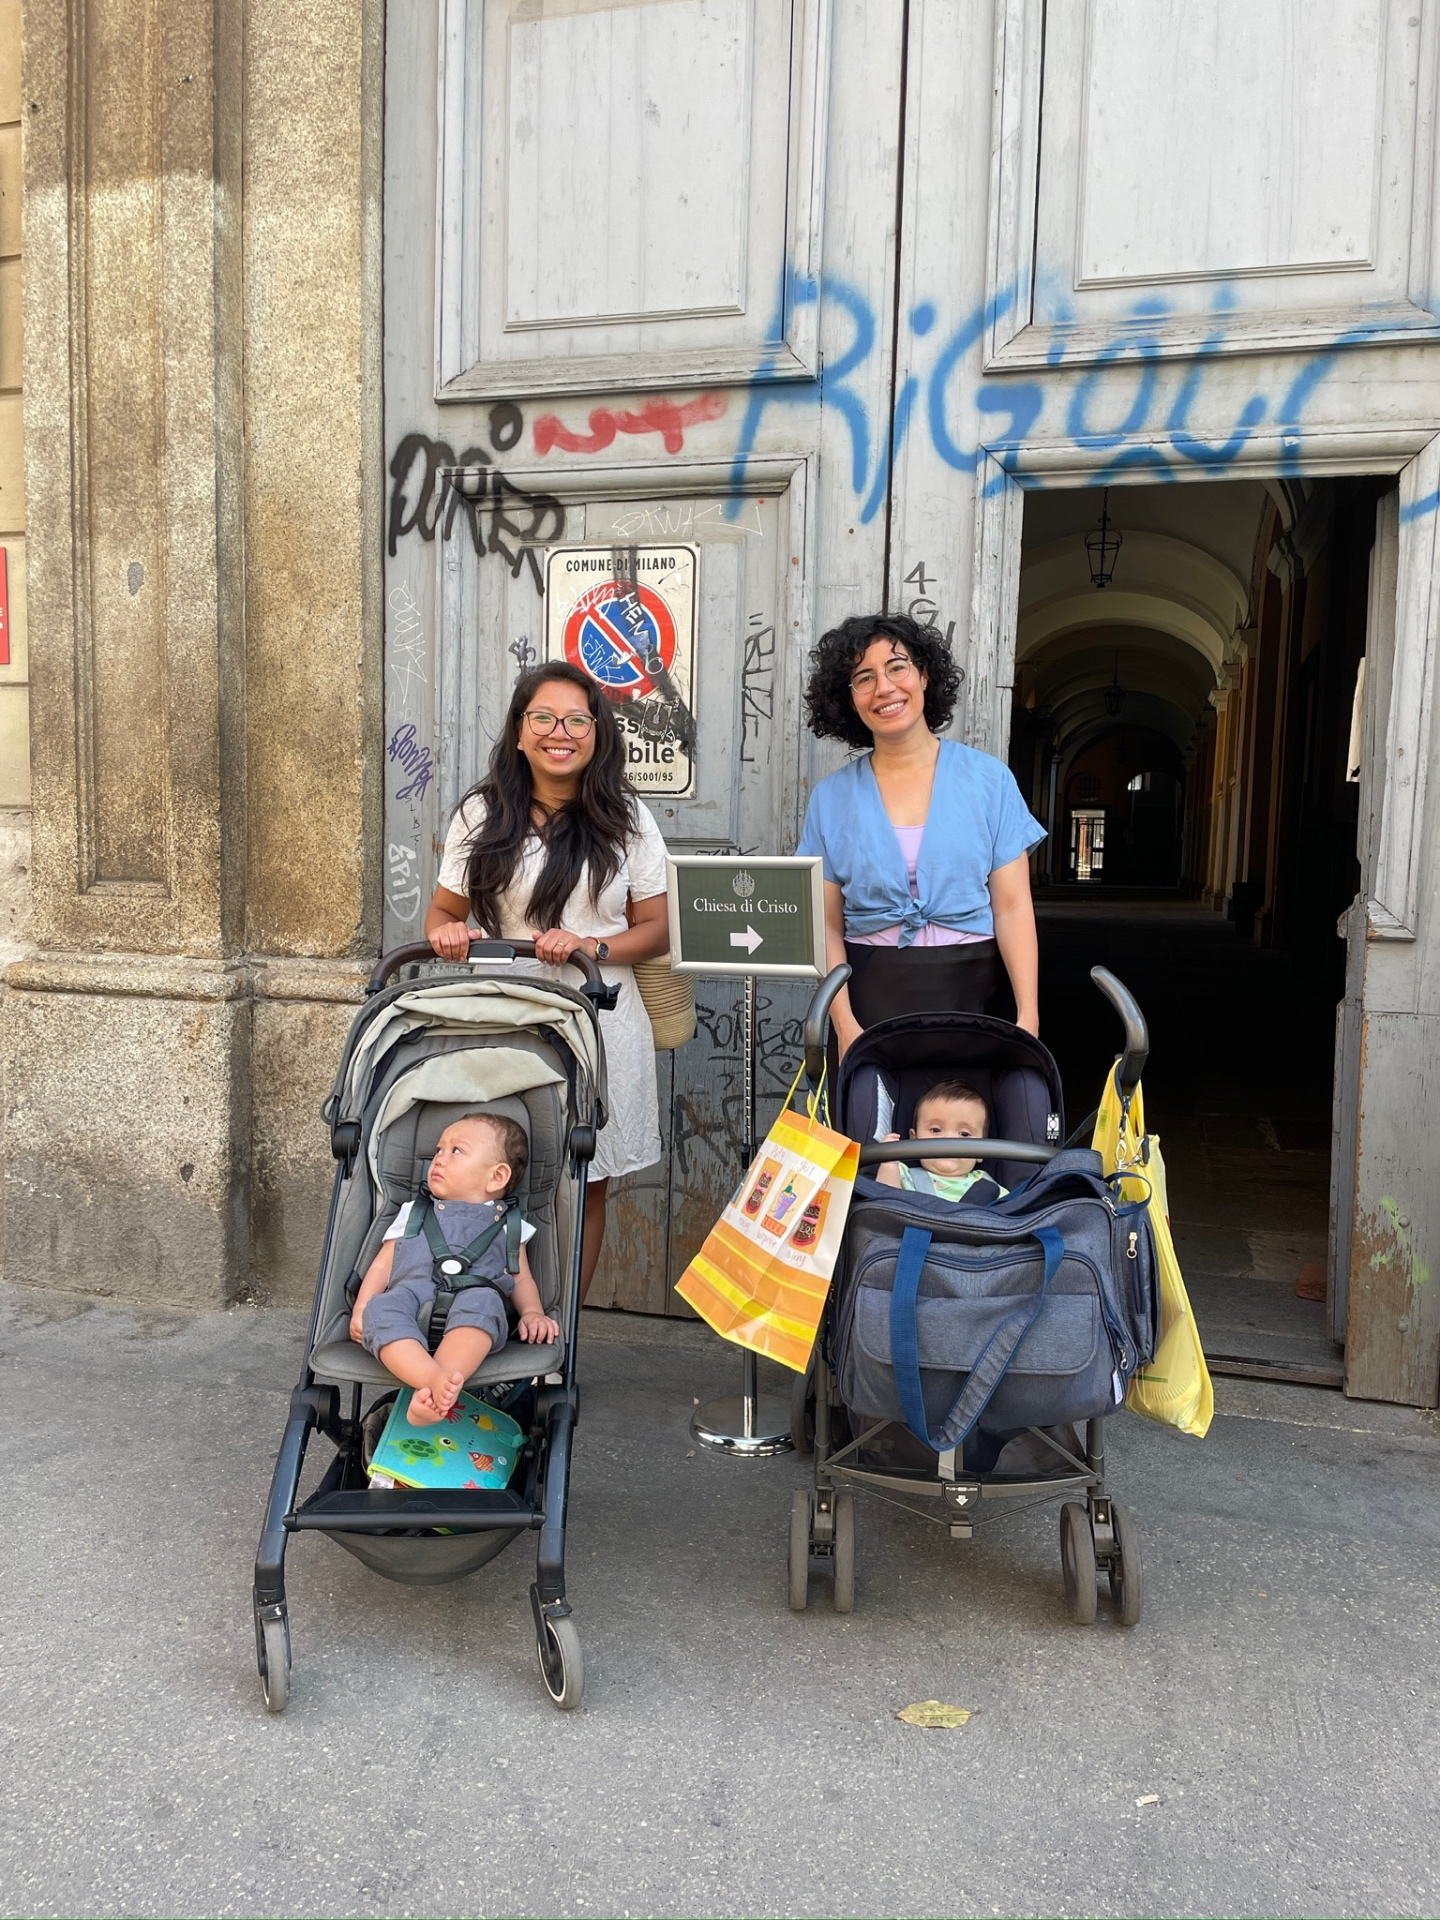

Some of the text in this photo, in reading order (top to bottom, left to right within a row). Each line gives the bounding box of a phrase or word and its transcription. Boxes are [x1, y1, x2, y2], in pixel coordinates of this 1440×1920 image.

[566, 559, 612, 572] COMUNE
[616, 558, 628, 571] DI
[628, 741, 675, 764] bile
[623, 772, 673, 782] 26/S001/95
[693, 898, 798, 914] Chiesa di Cristo
